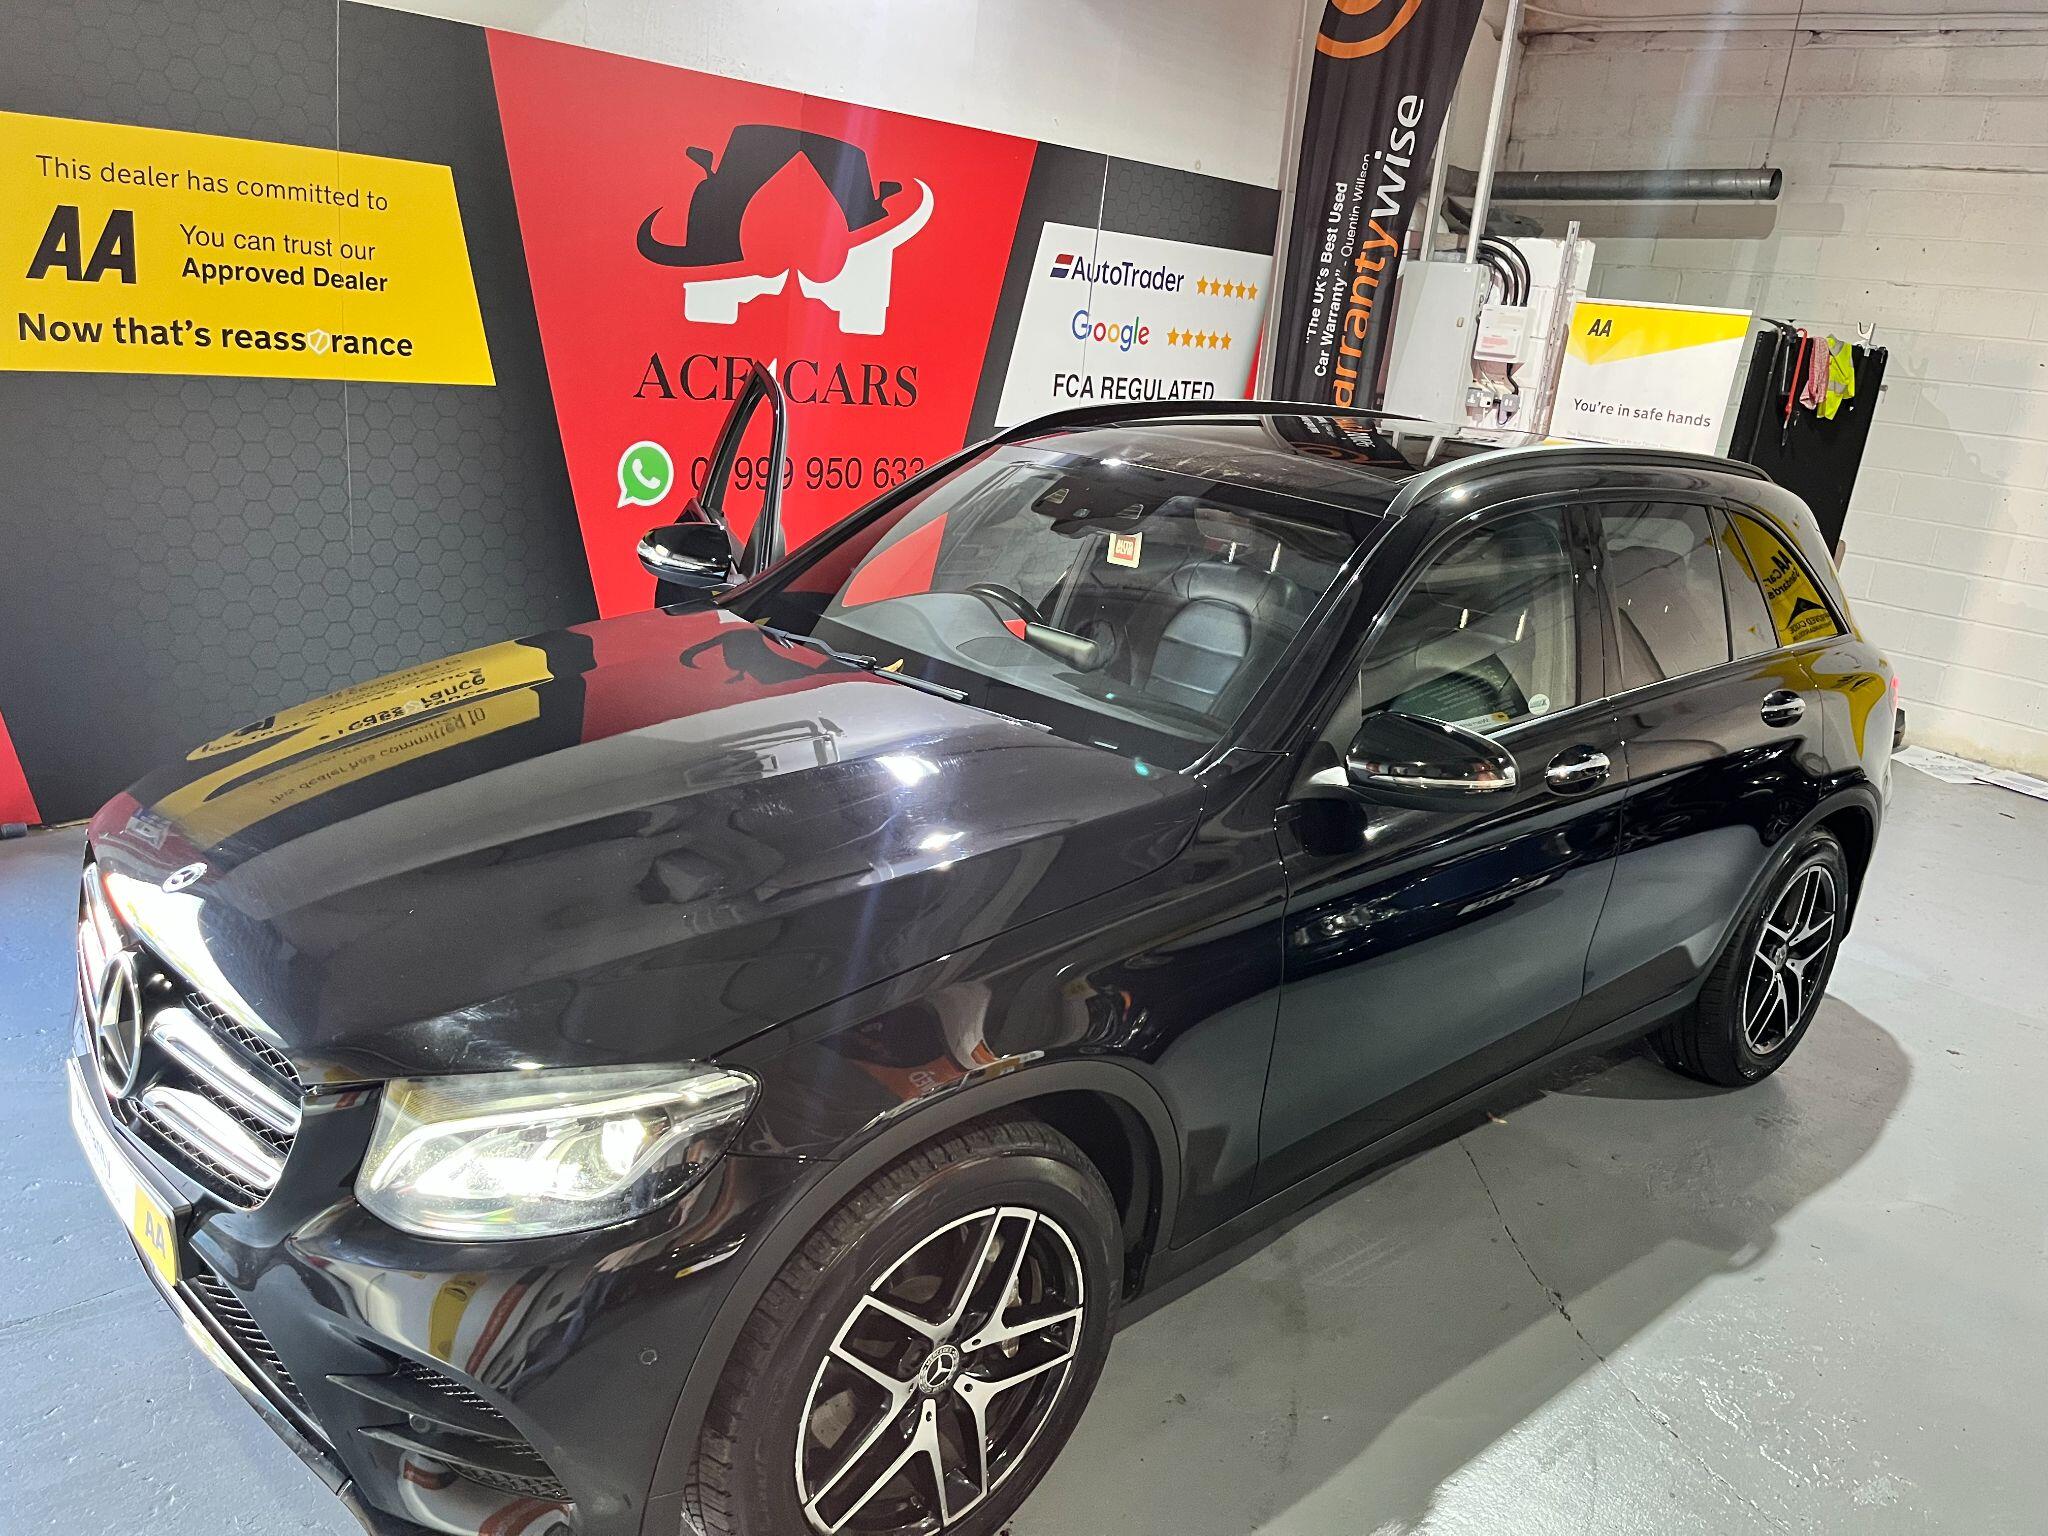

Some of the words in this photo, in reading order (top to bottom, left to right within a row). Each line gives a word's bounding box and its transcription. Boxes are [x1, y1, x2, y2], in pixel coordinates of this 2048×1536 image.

[36, 155, 91, 180] This
[101, 162, 179, 188] dealer
[188, 170, 228, 193] has
[237, 181, 358, 207] committed
[367, 191, 387, 210] to
[1328, 182, 1348, 223] Used
[26, 205, 136, 284] AA
[180, 224, 224, 247] You
[234, 234, 275, 251] can
[283, 235, 332, 256] trust
[341, 244, 375, 260] our
[1320, 227, 1339, 264] Best
[1333, 94, 1424, 408] arrantywise
[182, 258, 304, 285] Approved
[314, 268, 387, 291] Dealer
[1071, 256, 1185, 292] AutoTrader
[1314, 350, 1330, 377] Car
[1340, 206, 1361, 258] Quentin
[1353, 153, 1371, 202] Willson
[19, 313, 102, 342] Now
[1072, 309, 1150, 352] Google
[1587, 318, 1613, 338] AA
[783, 359, 917, 407] CARS
[1054, 374, 1093, 398] FCA
[1101, 376, 1215, 400] REGULATED
[1617, 404, 1630, 417] in
[1633, 408, 1663, 421] safe
[1666, 410, 1711, 428] hands
[691, 456, 794, 490] 0999
[806, 457, 862, 489] 950
[145, 1210, 166, 1259] AA
